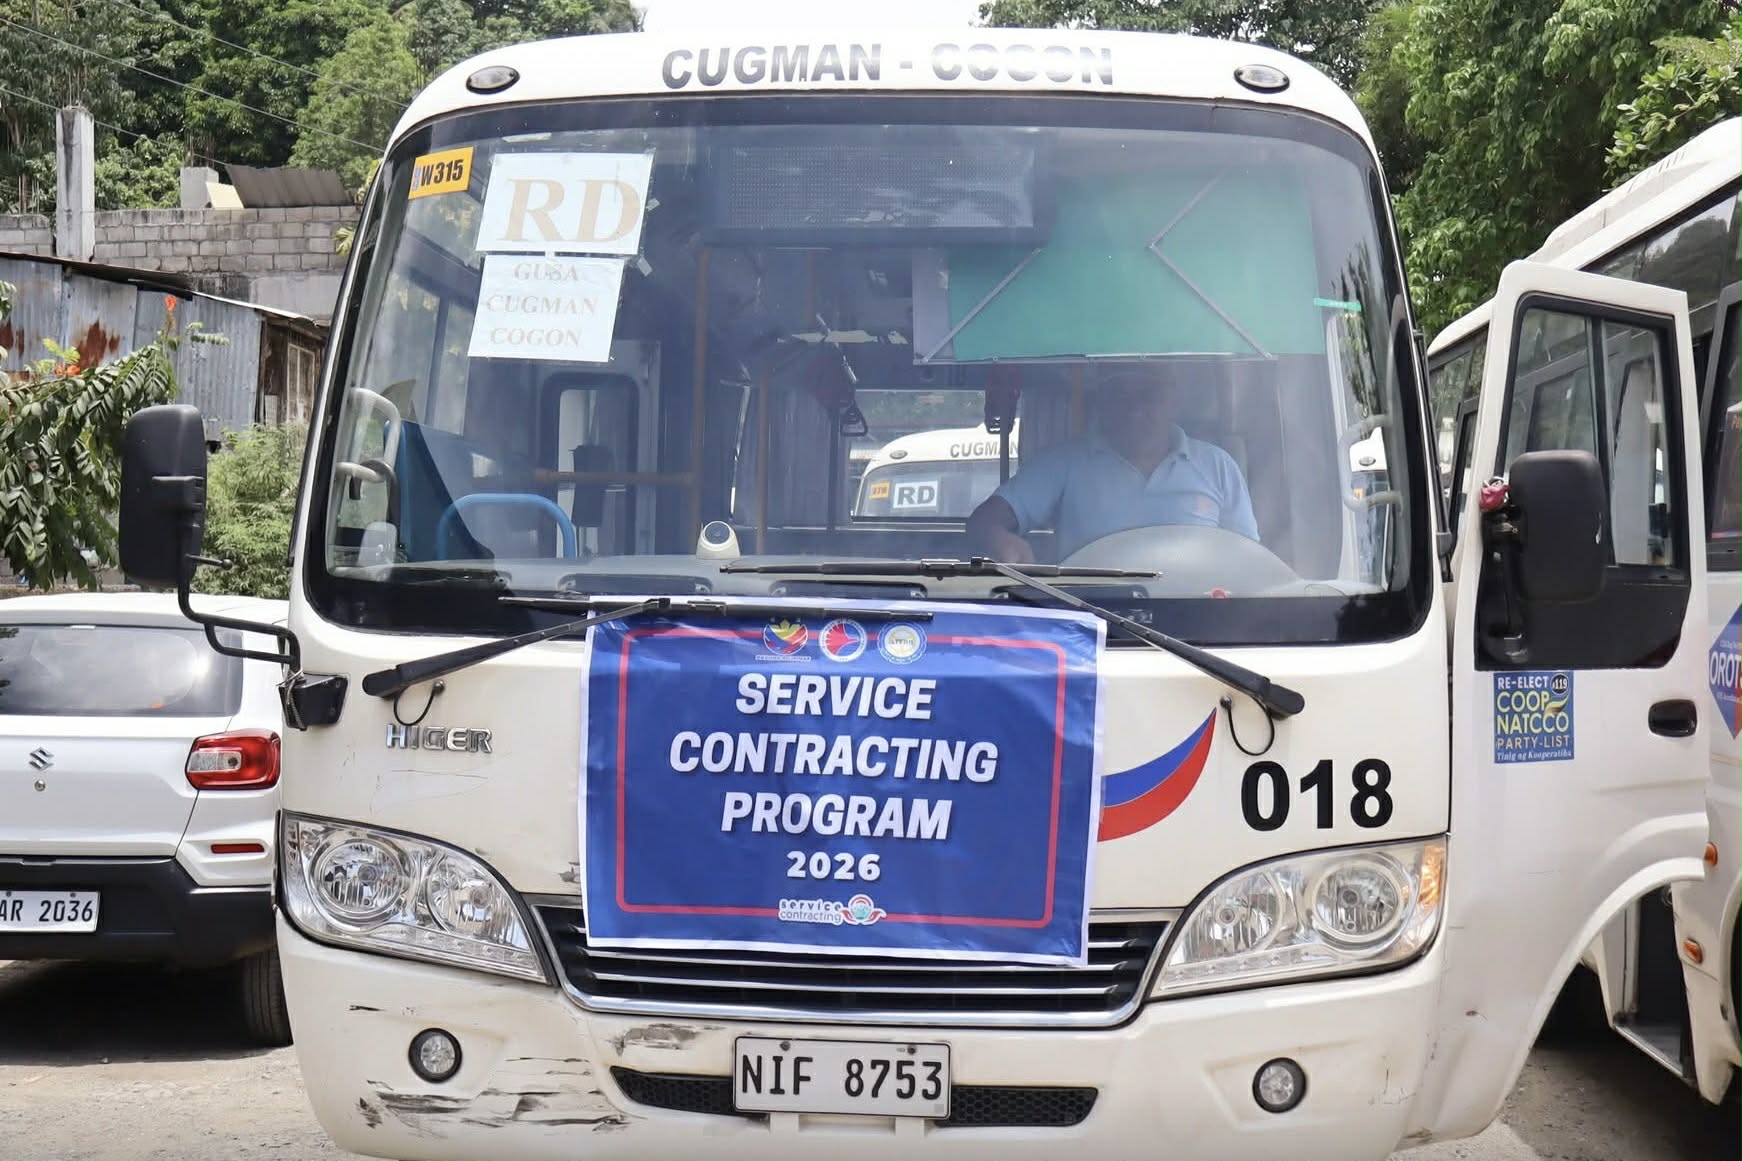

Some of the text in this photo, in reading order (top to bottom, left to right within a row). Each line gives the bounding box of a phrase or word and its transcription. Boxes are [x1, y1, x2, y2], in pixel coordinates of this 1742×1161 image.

[662, 44, 881, 89] CUGMAN
[496, 178, 641, 243] RD
[514, 263, 579, 281] GUSA
[486, 294, 597, 315] CUGMAN
[490, 328, 583, 346] COGON
[950, 442, 1018, 458] CUGMN
[897, 486, 935, 505] RD
[1710, 651, 1742, 688] OROT
[1498, 676, 1549, 689] RE-ELECT
[736, 672, 937, 720] SERVICE
[1497, 690, 1550, 712] COOP
[1497, 712, 1569, 735] NATCCO
[386, 724, 492, 753] HIGER
[1497, 735, 1570, 750] PARTY-LIST
[669, 731, 998, 783] CONTRACTING
[1241, 758, 1393, 831] 018
[721, 791, 952, 840] PROGRAM
[787, 850, 881, 881] 2026
[39, 900, 93, 922] 2036
[780, 910, 841, 923] contracting
[781, 900, 841, 911] service
[742, 1054, 942, 1100] NIF 8753
